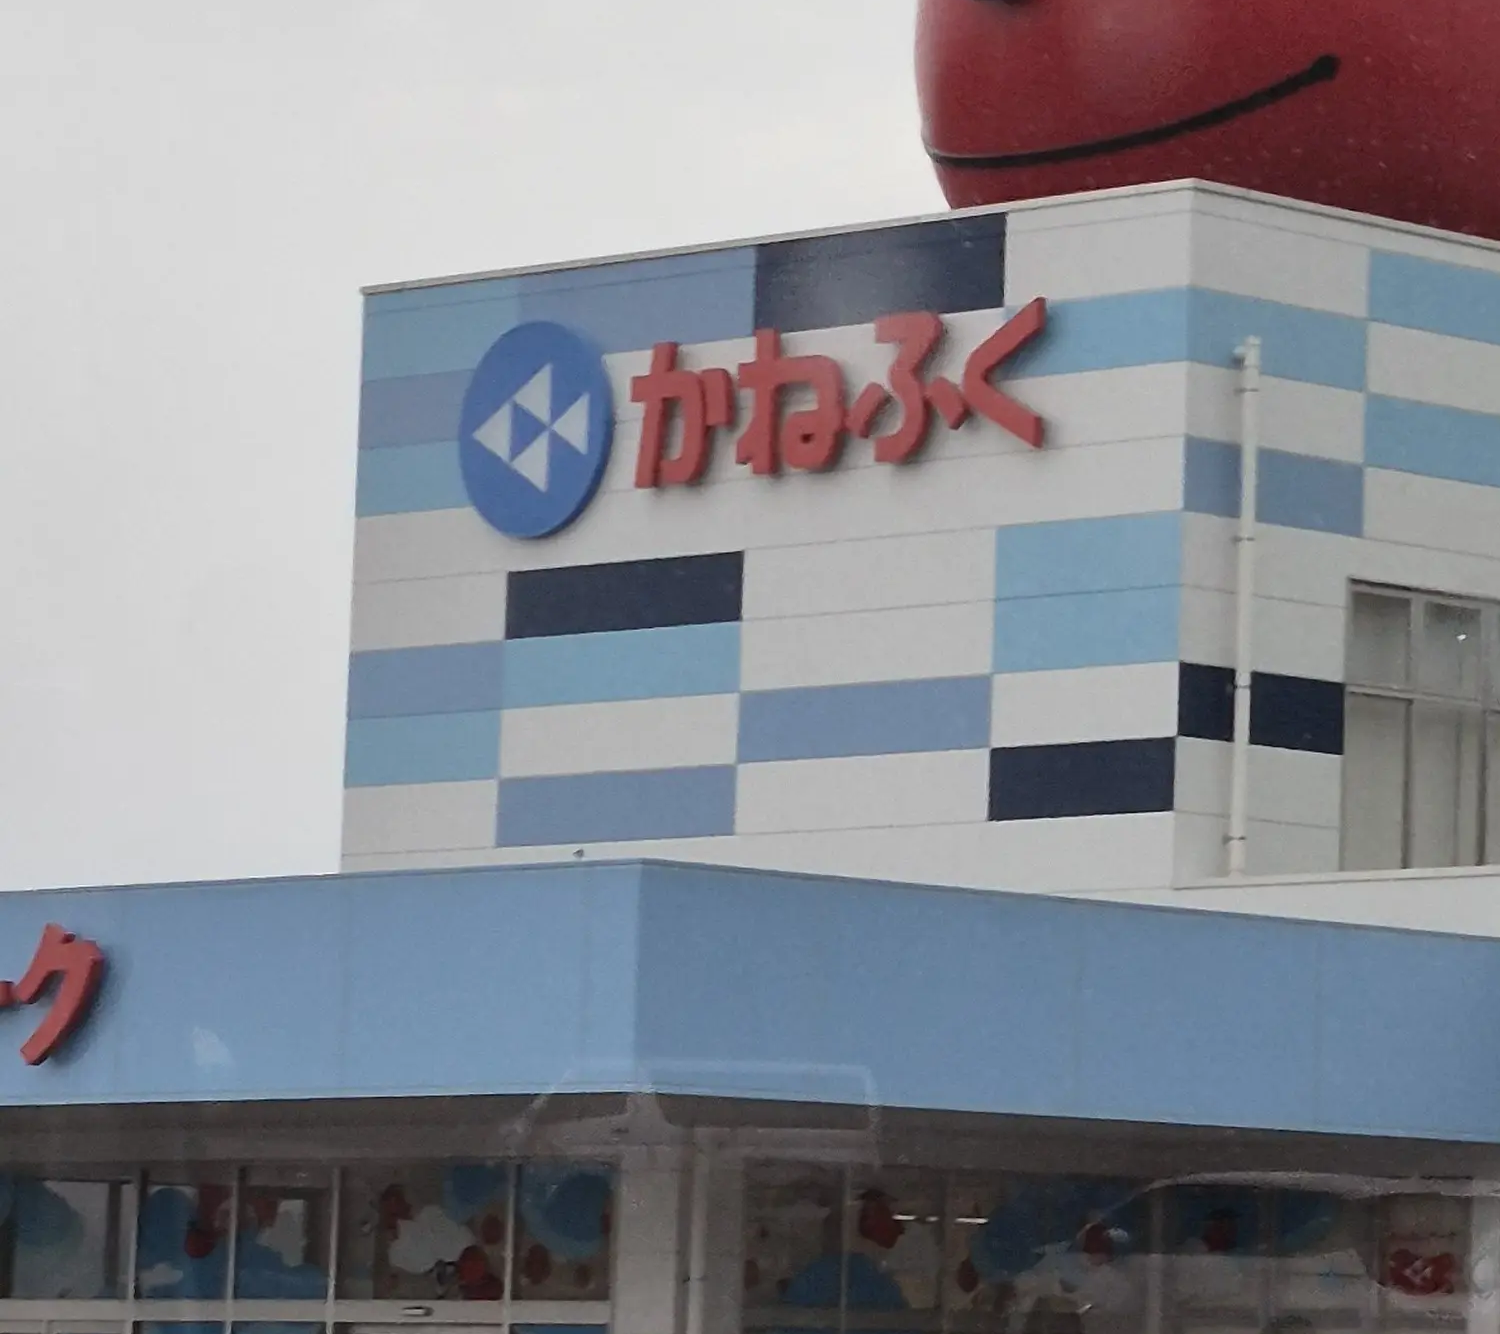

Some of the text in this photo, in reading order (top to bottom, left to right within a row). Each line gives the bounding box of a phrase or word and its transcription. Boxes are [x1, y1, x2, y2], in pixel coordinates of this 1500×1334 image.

[631, 297, 1047, 489] かねふく
[0, 923, 105, 1065] ク
